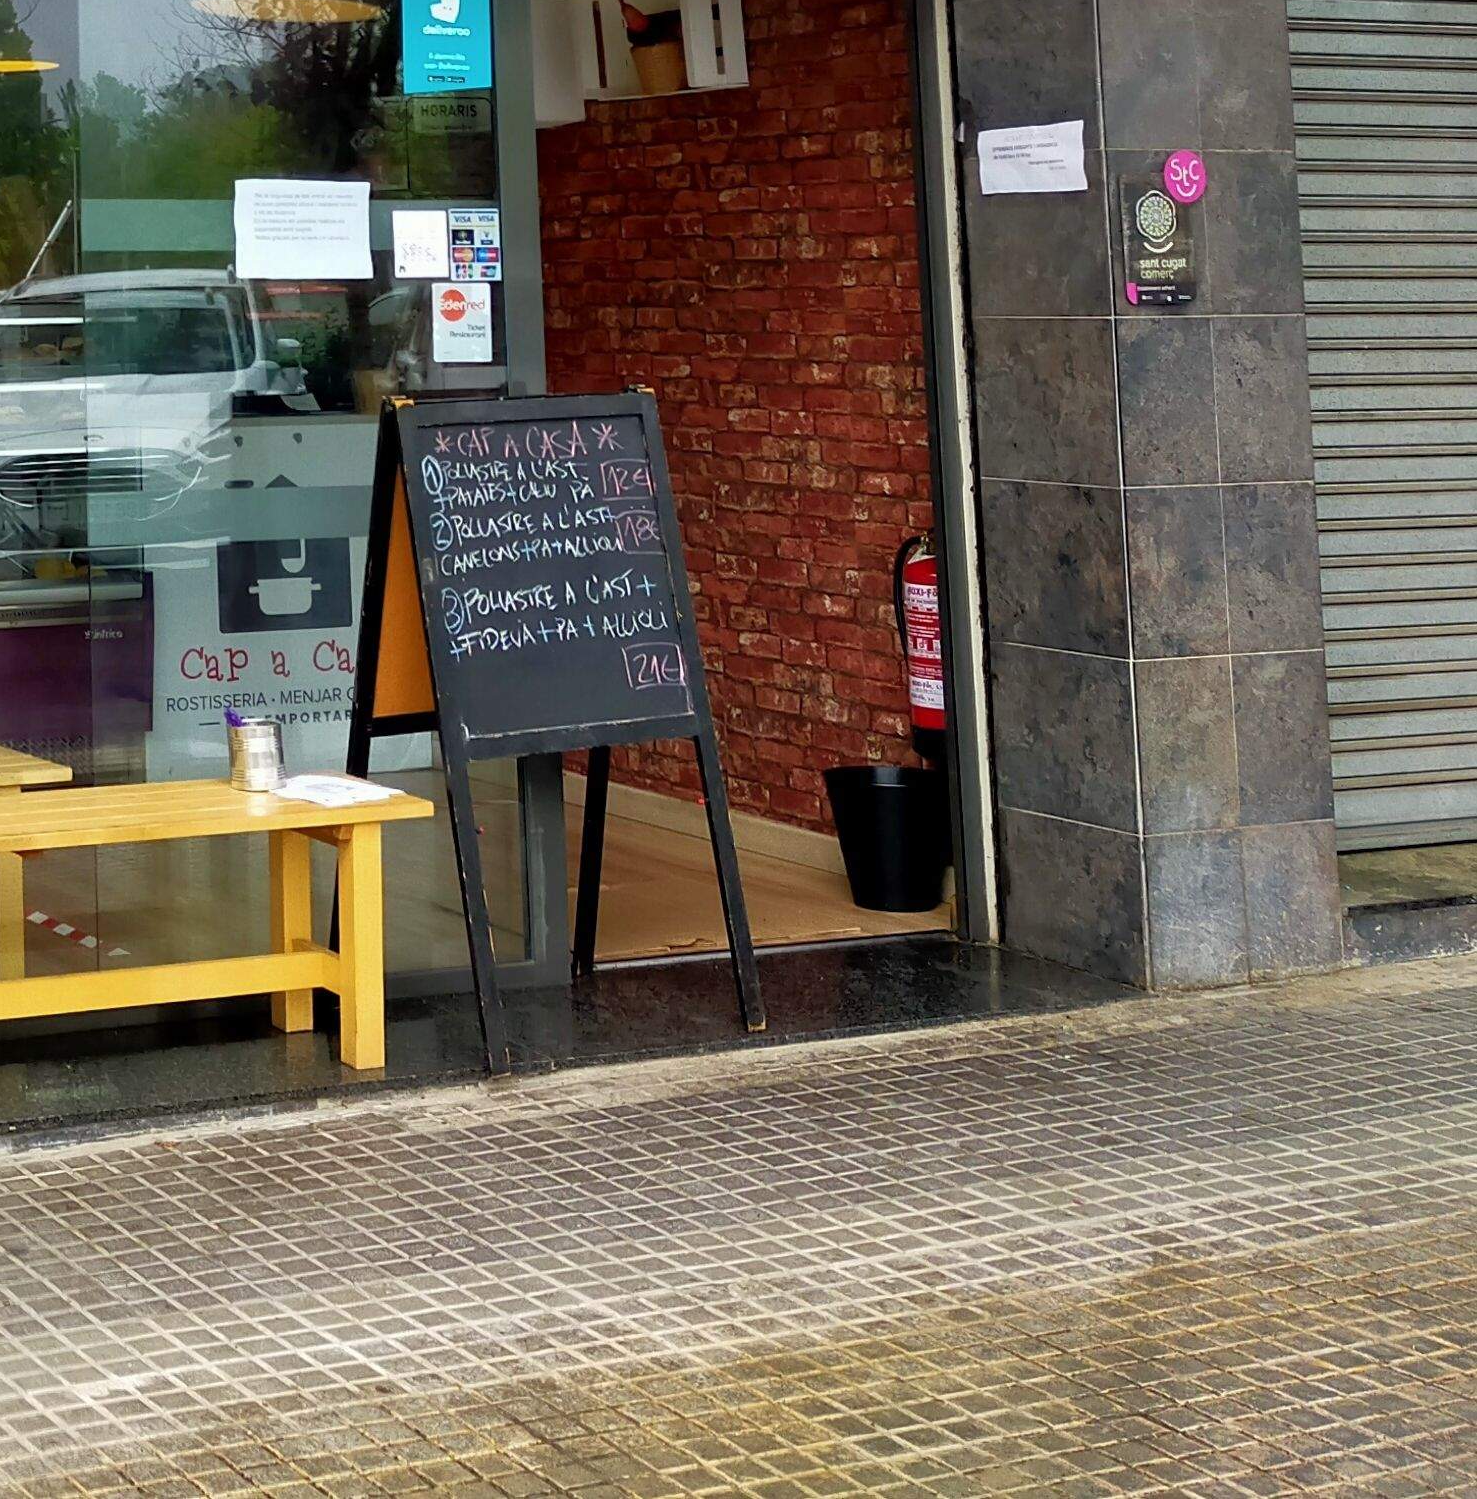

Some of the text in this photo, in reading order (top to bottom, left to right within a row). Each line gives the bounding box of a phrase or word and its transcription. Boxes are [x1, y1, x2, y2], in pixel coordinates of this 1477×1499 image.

[420, 104, 478, 118] HORARIS
[454, 214, 495, 223] VISA VISA
[1140, 258, 1187, 270] sant cugat
[526, 420, 588, 460] CASA
[565, 580, 576, 606] A
[180, 639, 355, 682] Cap a Ca
[166, 691, 267, 712] ROSTISSERIA
[280, 687, 342, 705] MENJAR
[265, 710, 352, 725] MPORTAR
